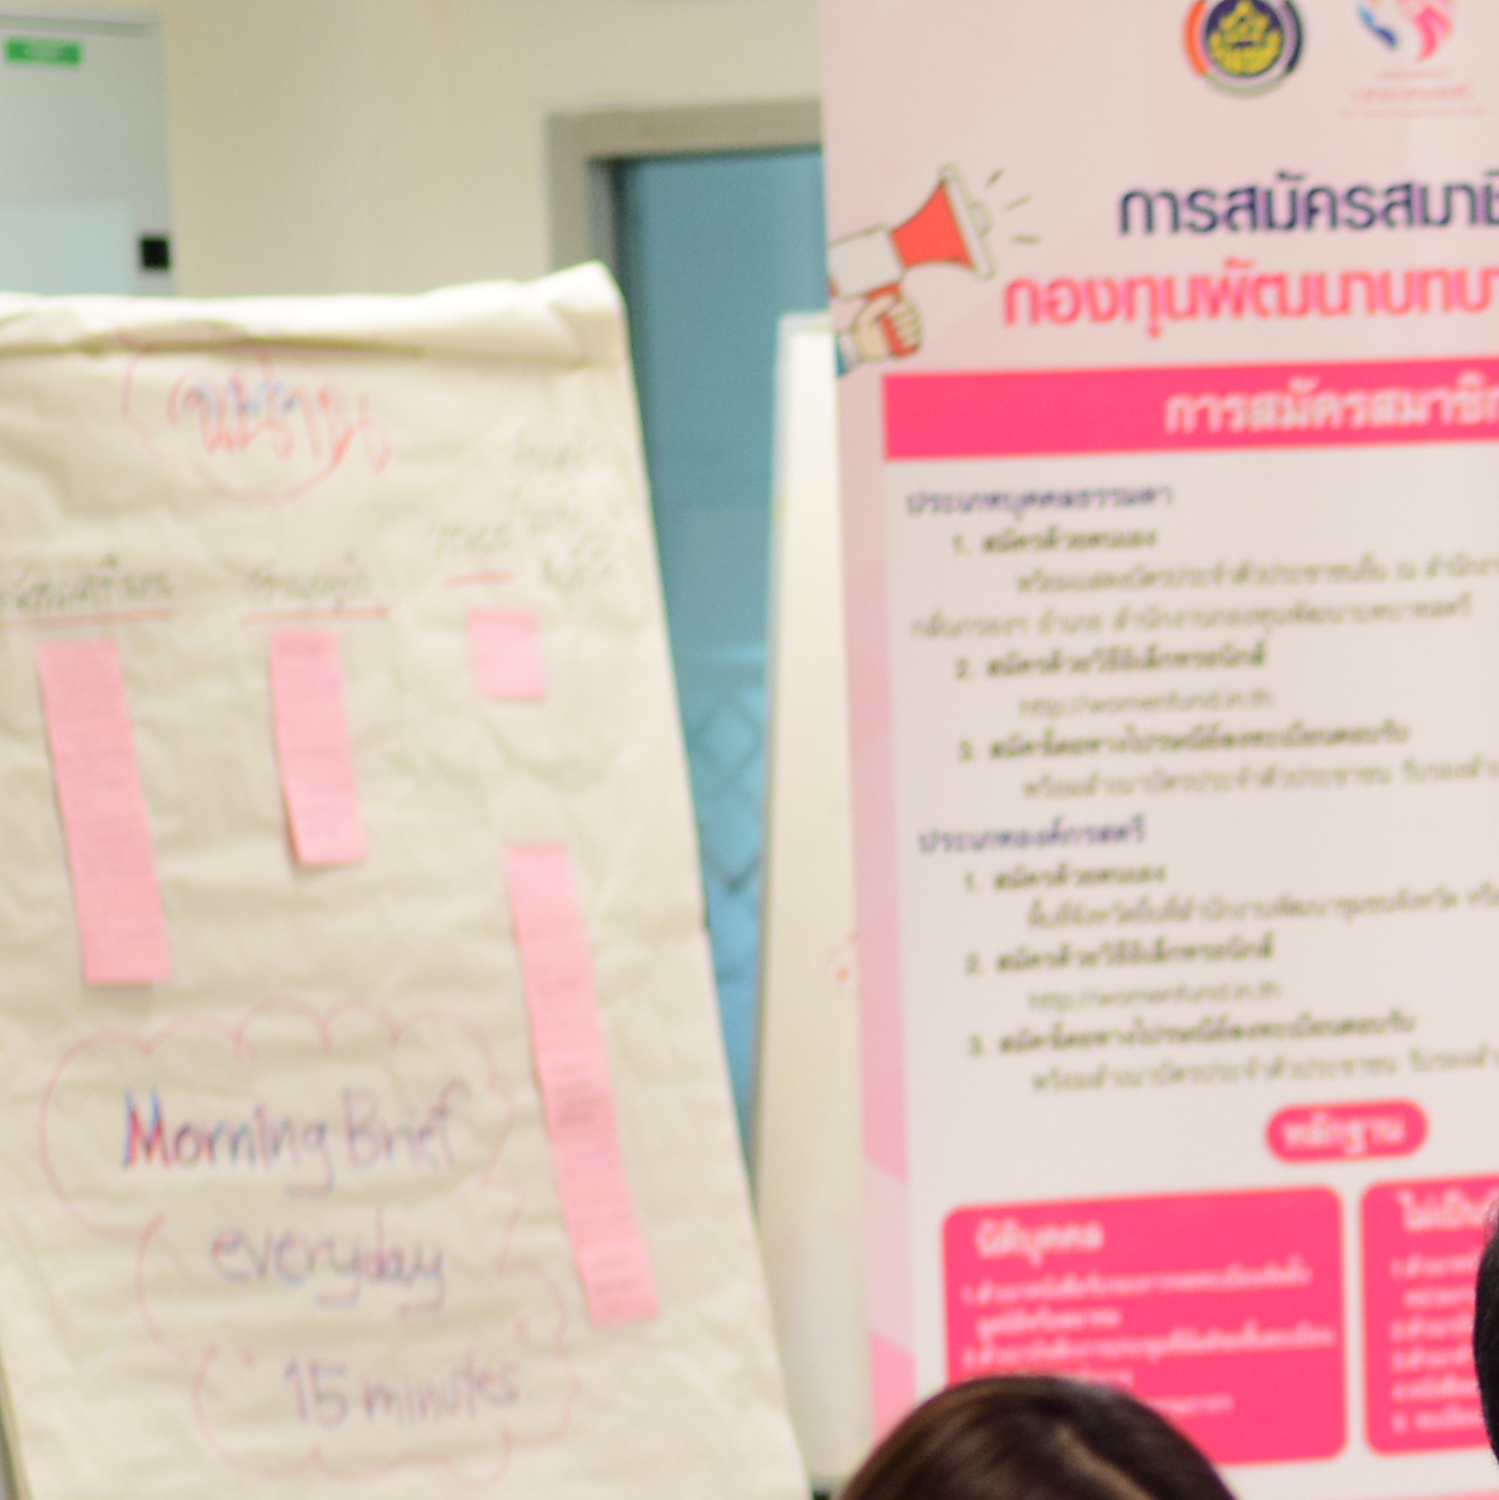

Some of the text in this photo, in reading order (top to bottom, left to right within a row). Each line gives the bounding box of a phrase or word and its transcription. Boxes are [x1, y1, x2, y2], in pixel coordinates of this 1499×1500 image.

[121, 1077, 467, 1197] Morning Brief
[209, 1206, 447, 1313] everyday
[284, 1350, 521, 1431] 15 minutes
